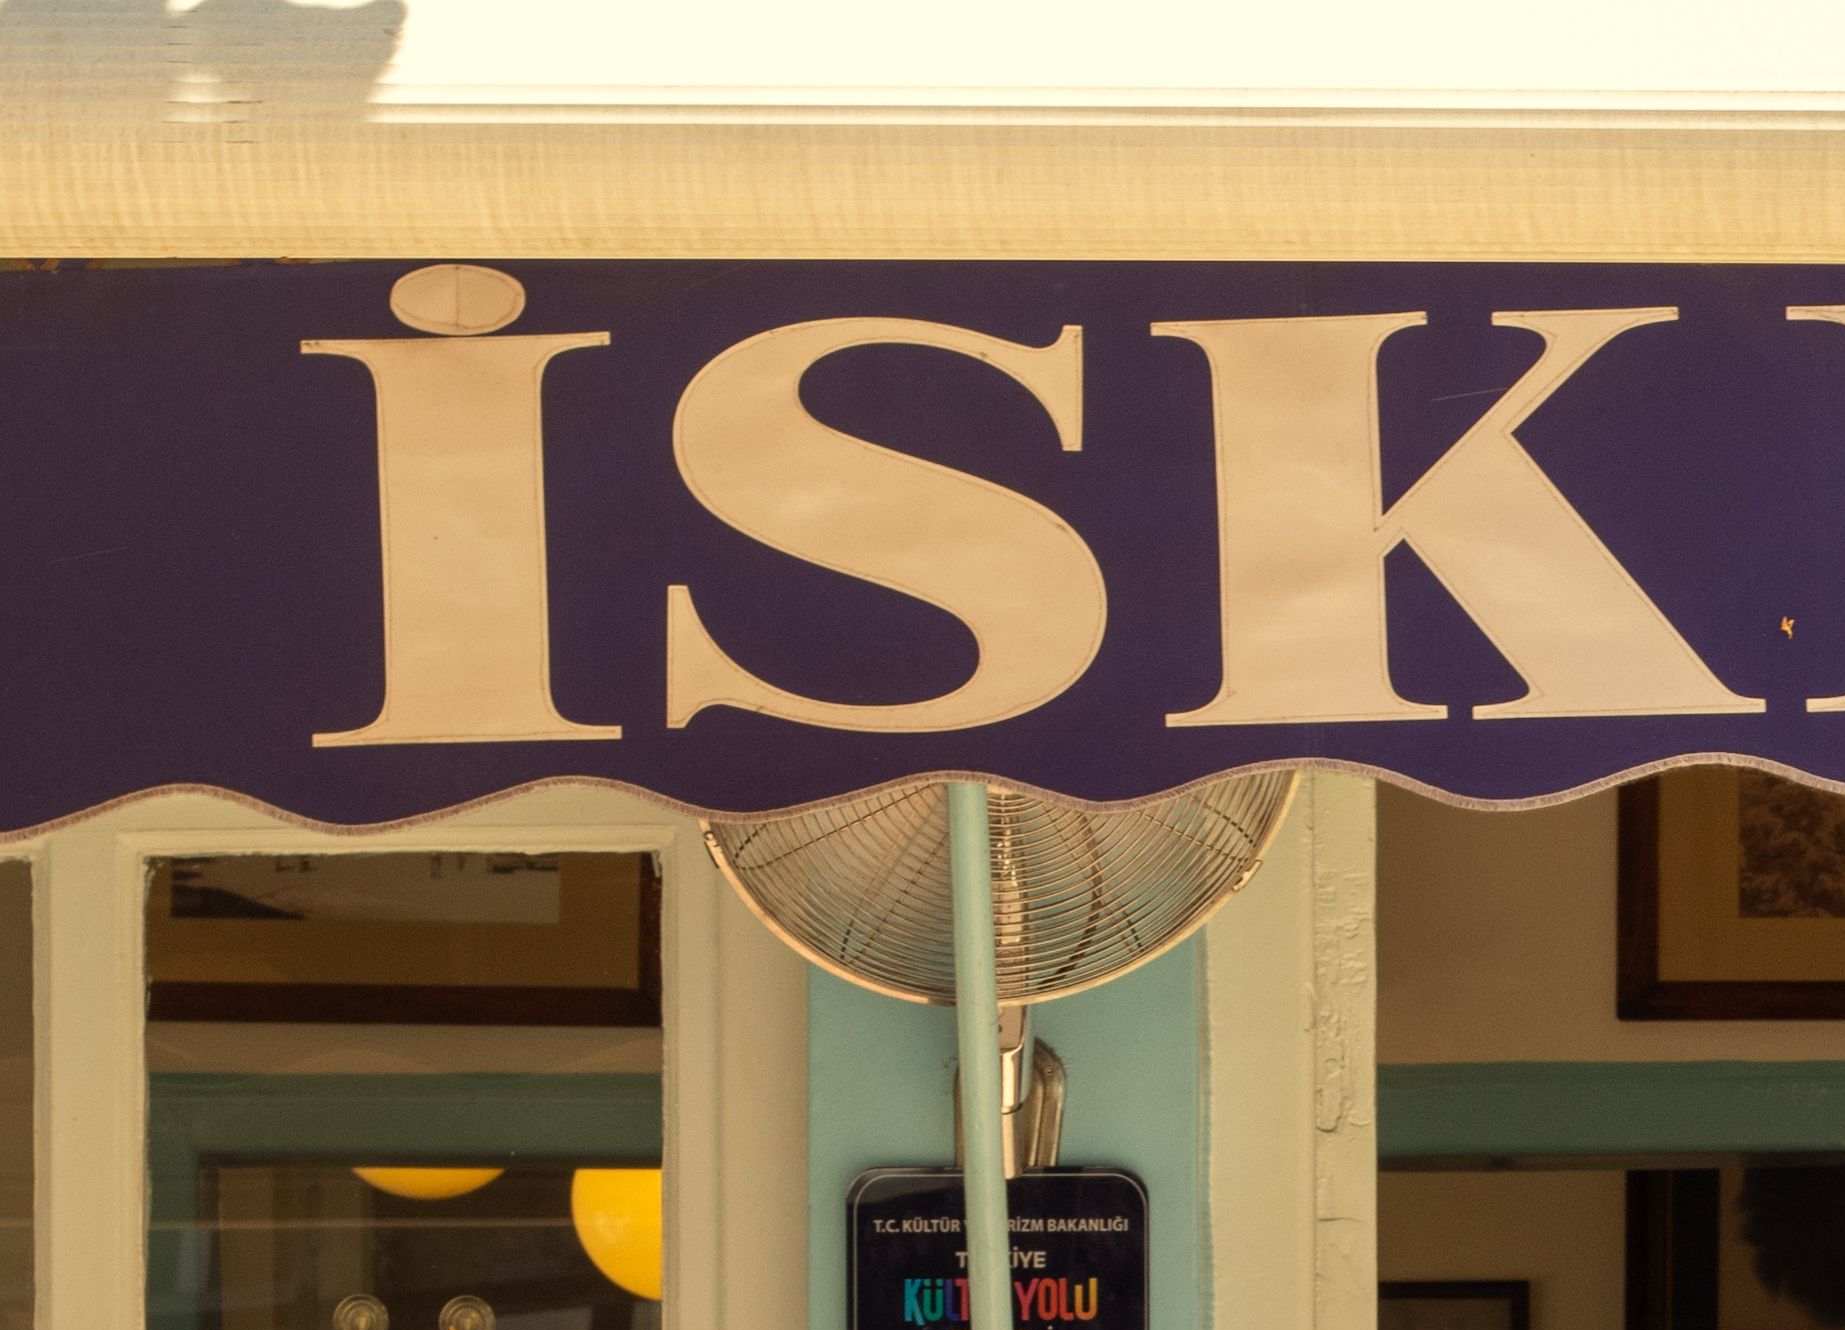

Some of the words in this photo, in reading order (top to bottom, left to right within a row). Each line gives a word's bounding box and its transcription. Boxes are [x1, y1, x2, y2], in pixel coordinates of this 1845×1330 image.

[873, 1219, 900, 1234] T.C.
[901, 1216, 961, 1234] KÜLTÜR
[1047, 1217, 1130, 1233] BAKANLIĞI
[1013, 1277, 1099, 1322] YOLU
